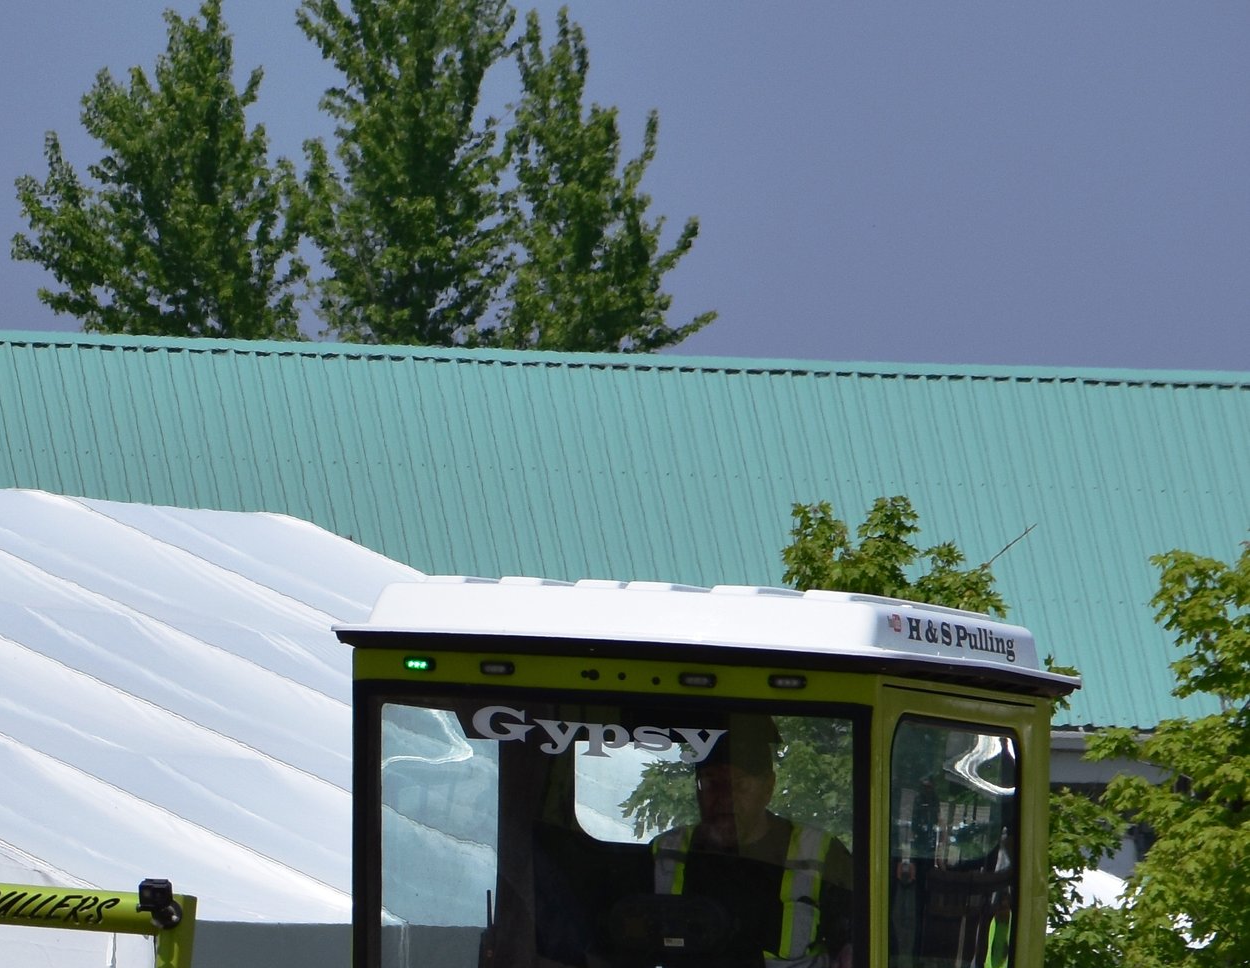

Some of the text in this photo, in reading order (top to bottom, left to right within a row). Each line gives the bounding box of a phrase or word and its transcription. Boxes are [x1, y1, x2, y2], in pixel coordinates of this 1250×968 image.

[906, 617, 922, 641] H
[925, 619, 938, 644] &
[941, 622, 951, 646] S
[954, 624, 1016, 662] Pulling
[472, 706, 729, 764] Gypsy
